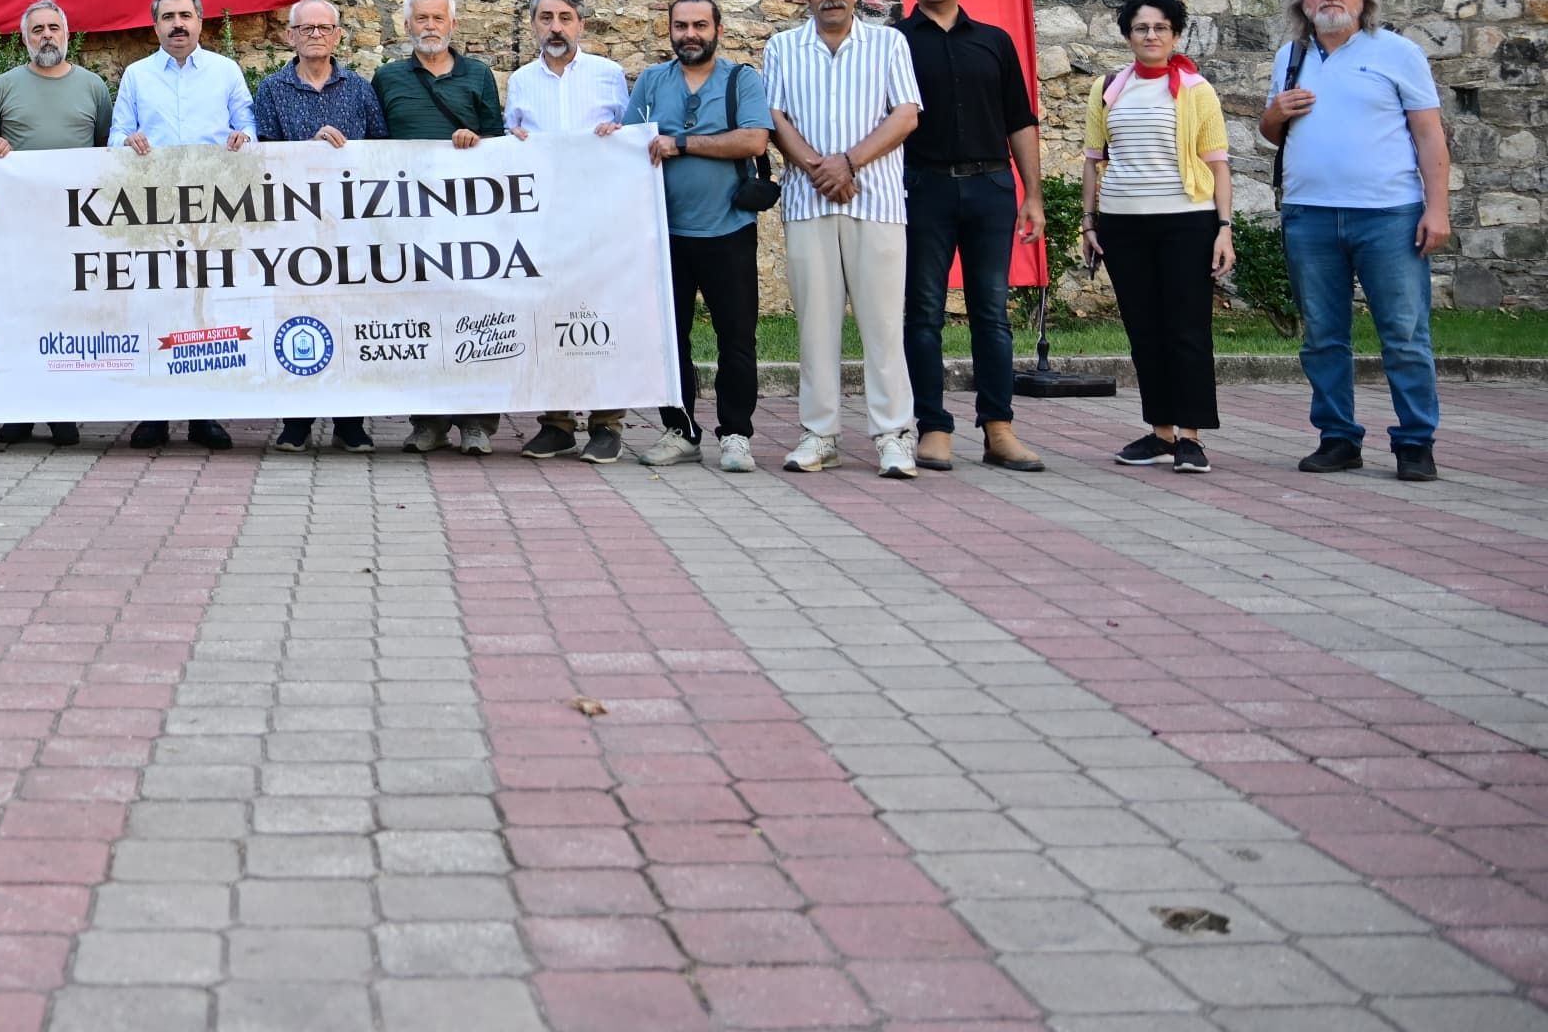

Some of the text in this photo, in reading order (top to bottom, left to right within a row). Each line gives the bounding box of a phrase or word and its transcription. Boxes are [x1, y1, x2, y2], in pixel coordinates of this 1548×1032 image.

[65, 170, 540, 227] KALEMİN İZİNDE
[71, 238, 543, 291] FETİH YOLUNDA
[355, 320, 432, 340] KÜLTÜR
[455, 312, 516, 336] Beylikten
[555, 321, 610, 348] 700
[172, 327, 237, 344] YILDIRIM AŞKIYLA
[276, 324, 291, 350] BURSA
[173, 340, 238, 359] DURMADAN
[360, 343, 429, 361] SANAT
[167, 354, 246, 375] YORULMADAN
